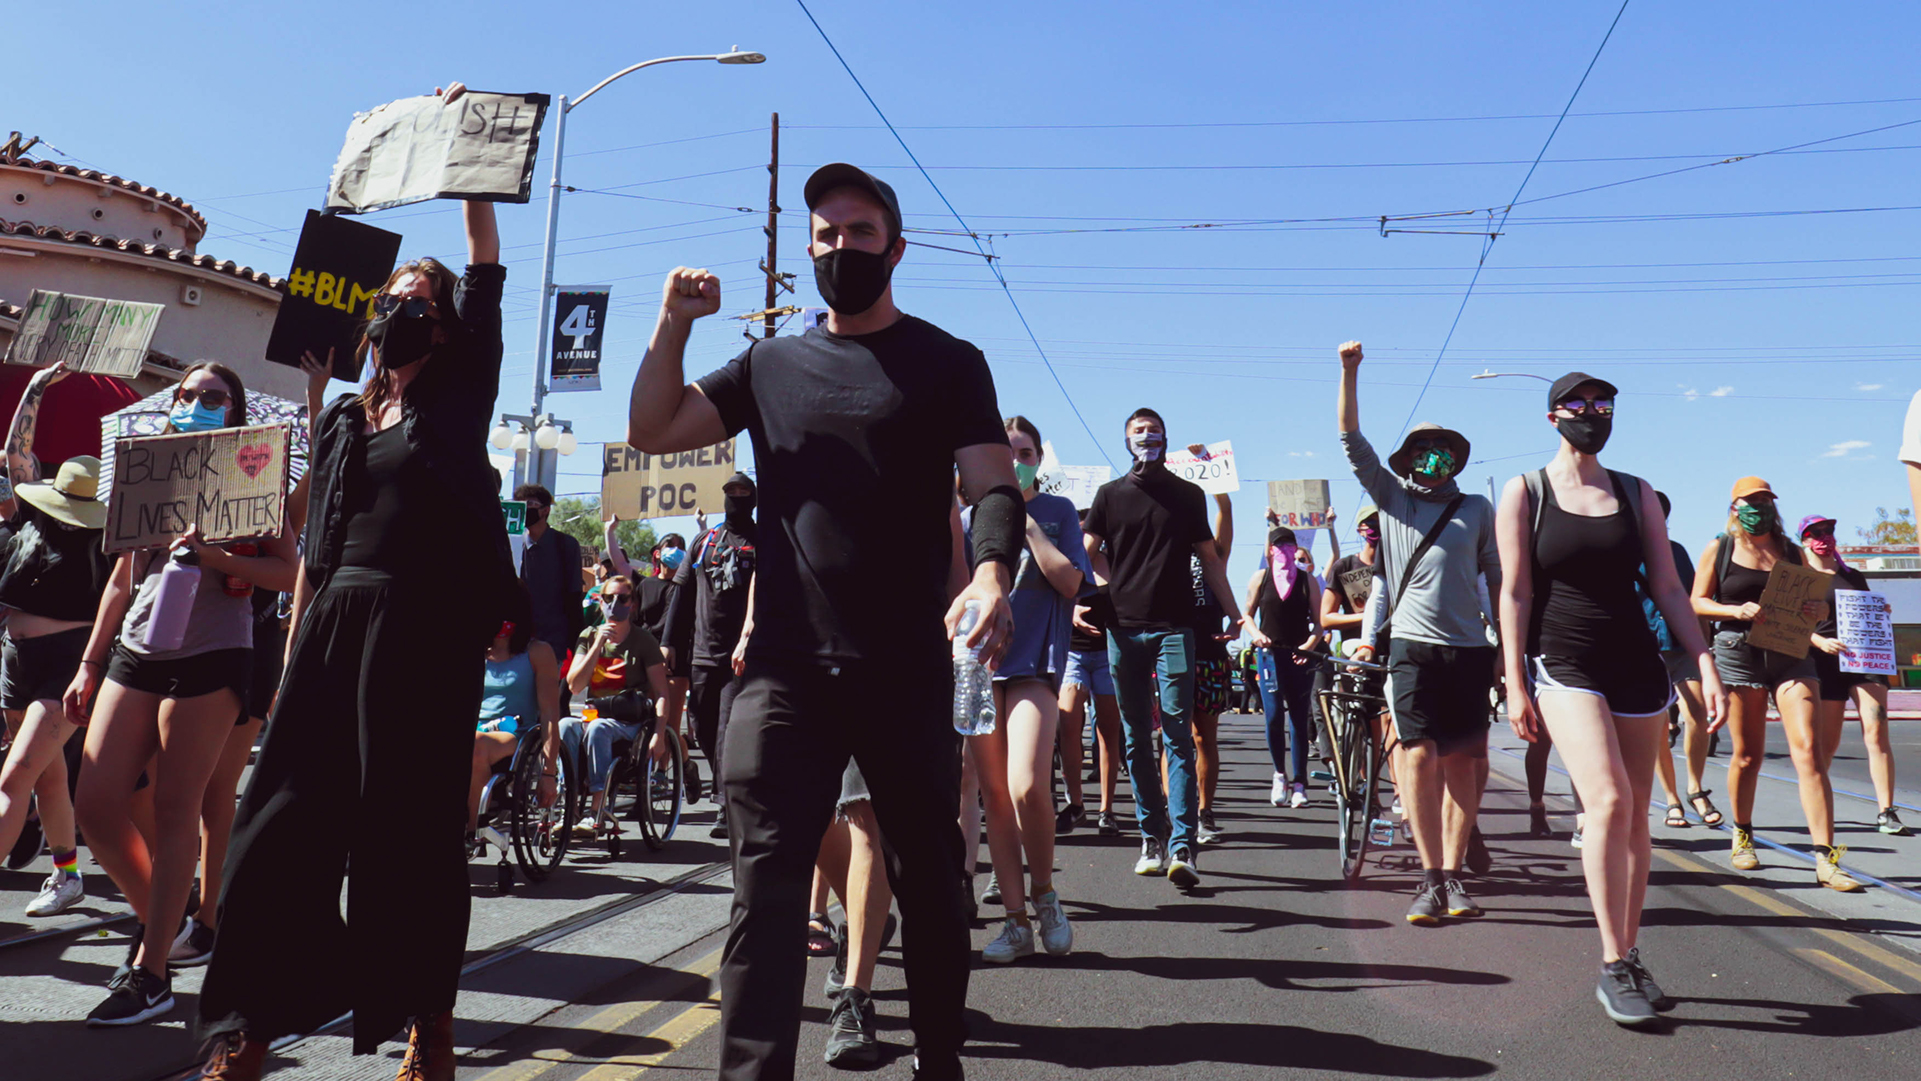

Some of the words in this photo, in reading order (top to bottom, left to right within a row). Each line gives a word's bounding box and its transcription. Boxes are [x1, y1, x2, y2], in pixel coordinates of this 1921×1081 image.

[287, 267, 379, 320] #BLM
[28, 294, 93, 322] HOW
[556, 350, 597, 360] AVENUE
[120, 447, 219, 485] BLACK
[640, 482, 697, 513] POC
[1859, 652, 1892, 660] JUSTICE
[1863, 661, 1890, 670] PEACE
